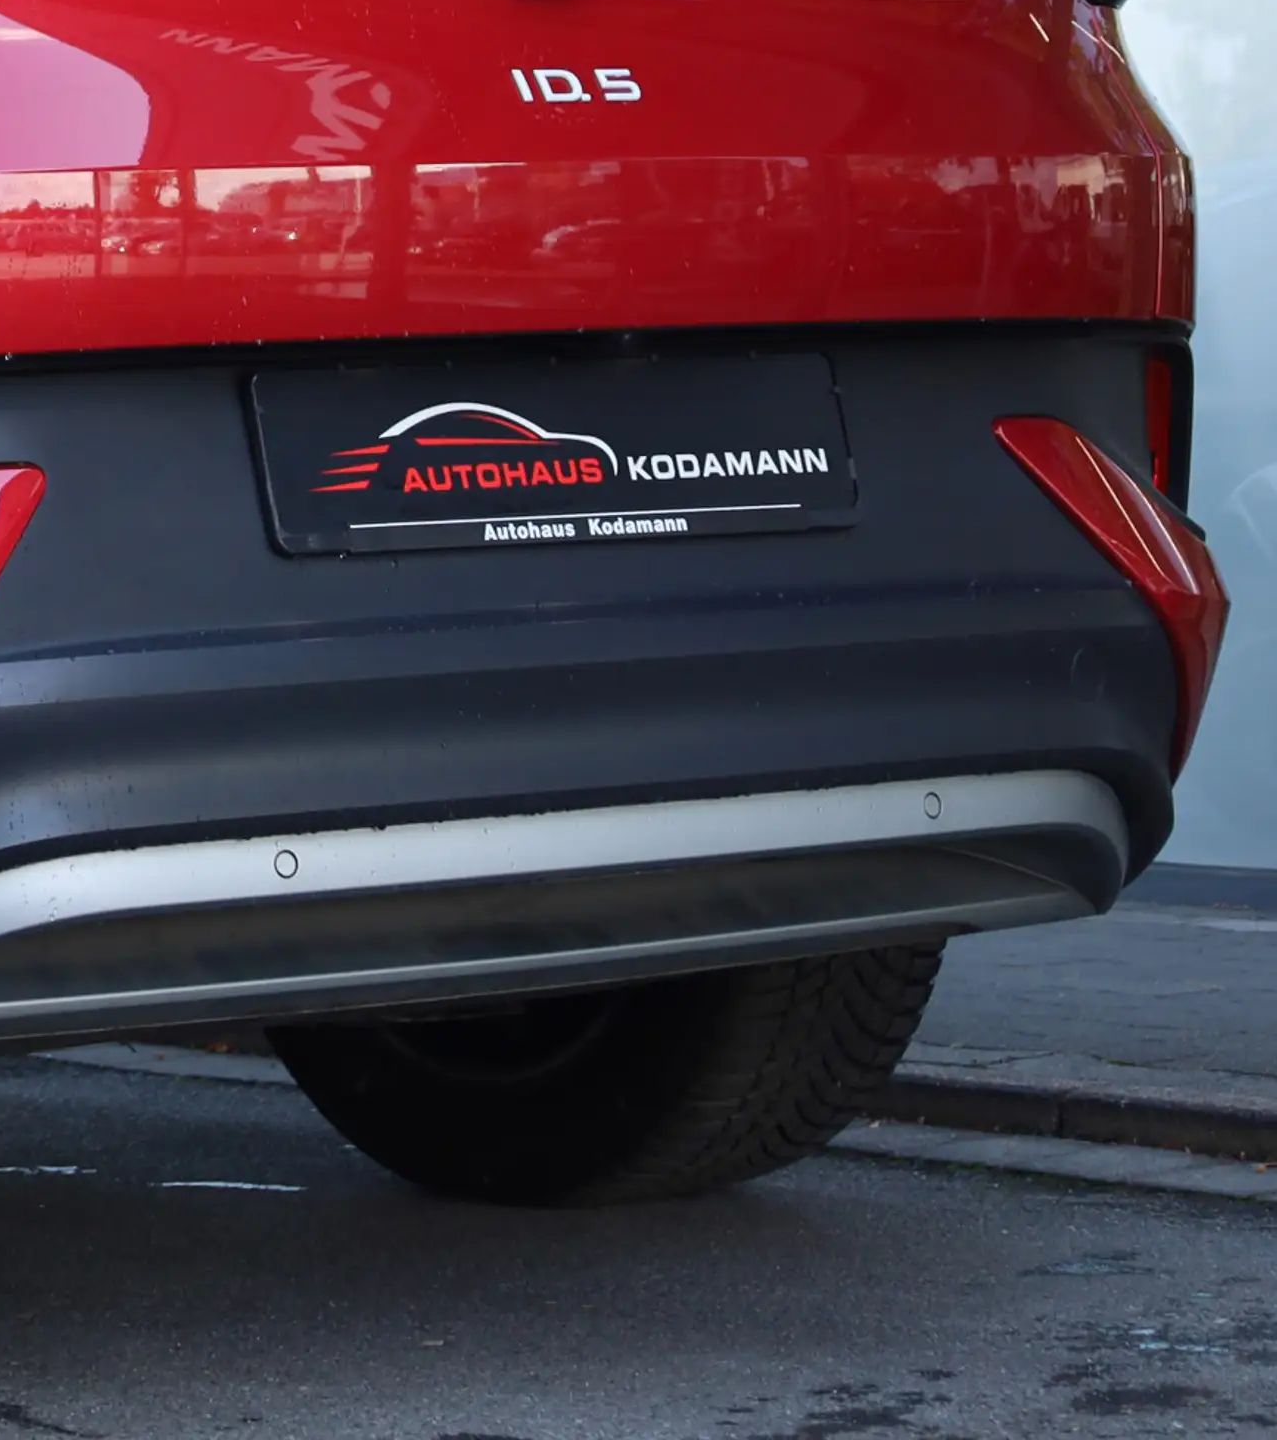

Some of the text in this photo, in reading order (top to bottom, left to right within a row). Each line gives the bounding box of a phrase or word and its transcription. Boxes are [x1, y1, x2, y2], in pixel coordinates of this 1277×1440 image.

[511, 68, 642, 102] ID.5
[402, 447, 829, 494] AUTOHAUS KODAMANN
[483, 514, 688, 542] Autohaus Kodamann
